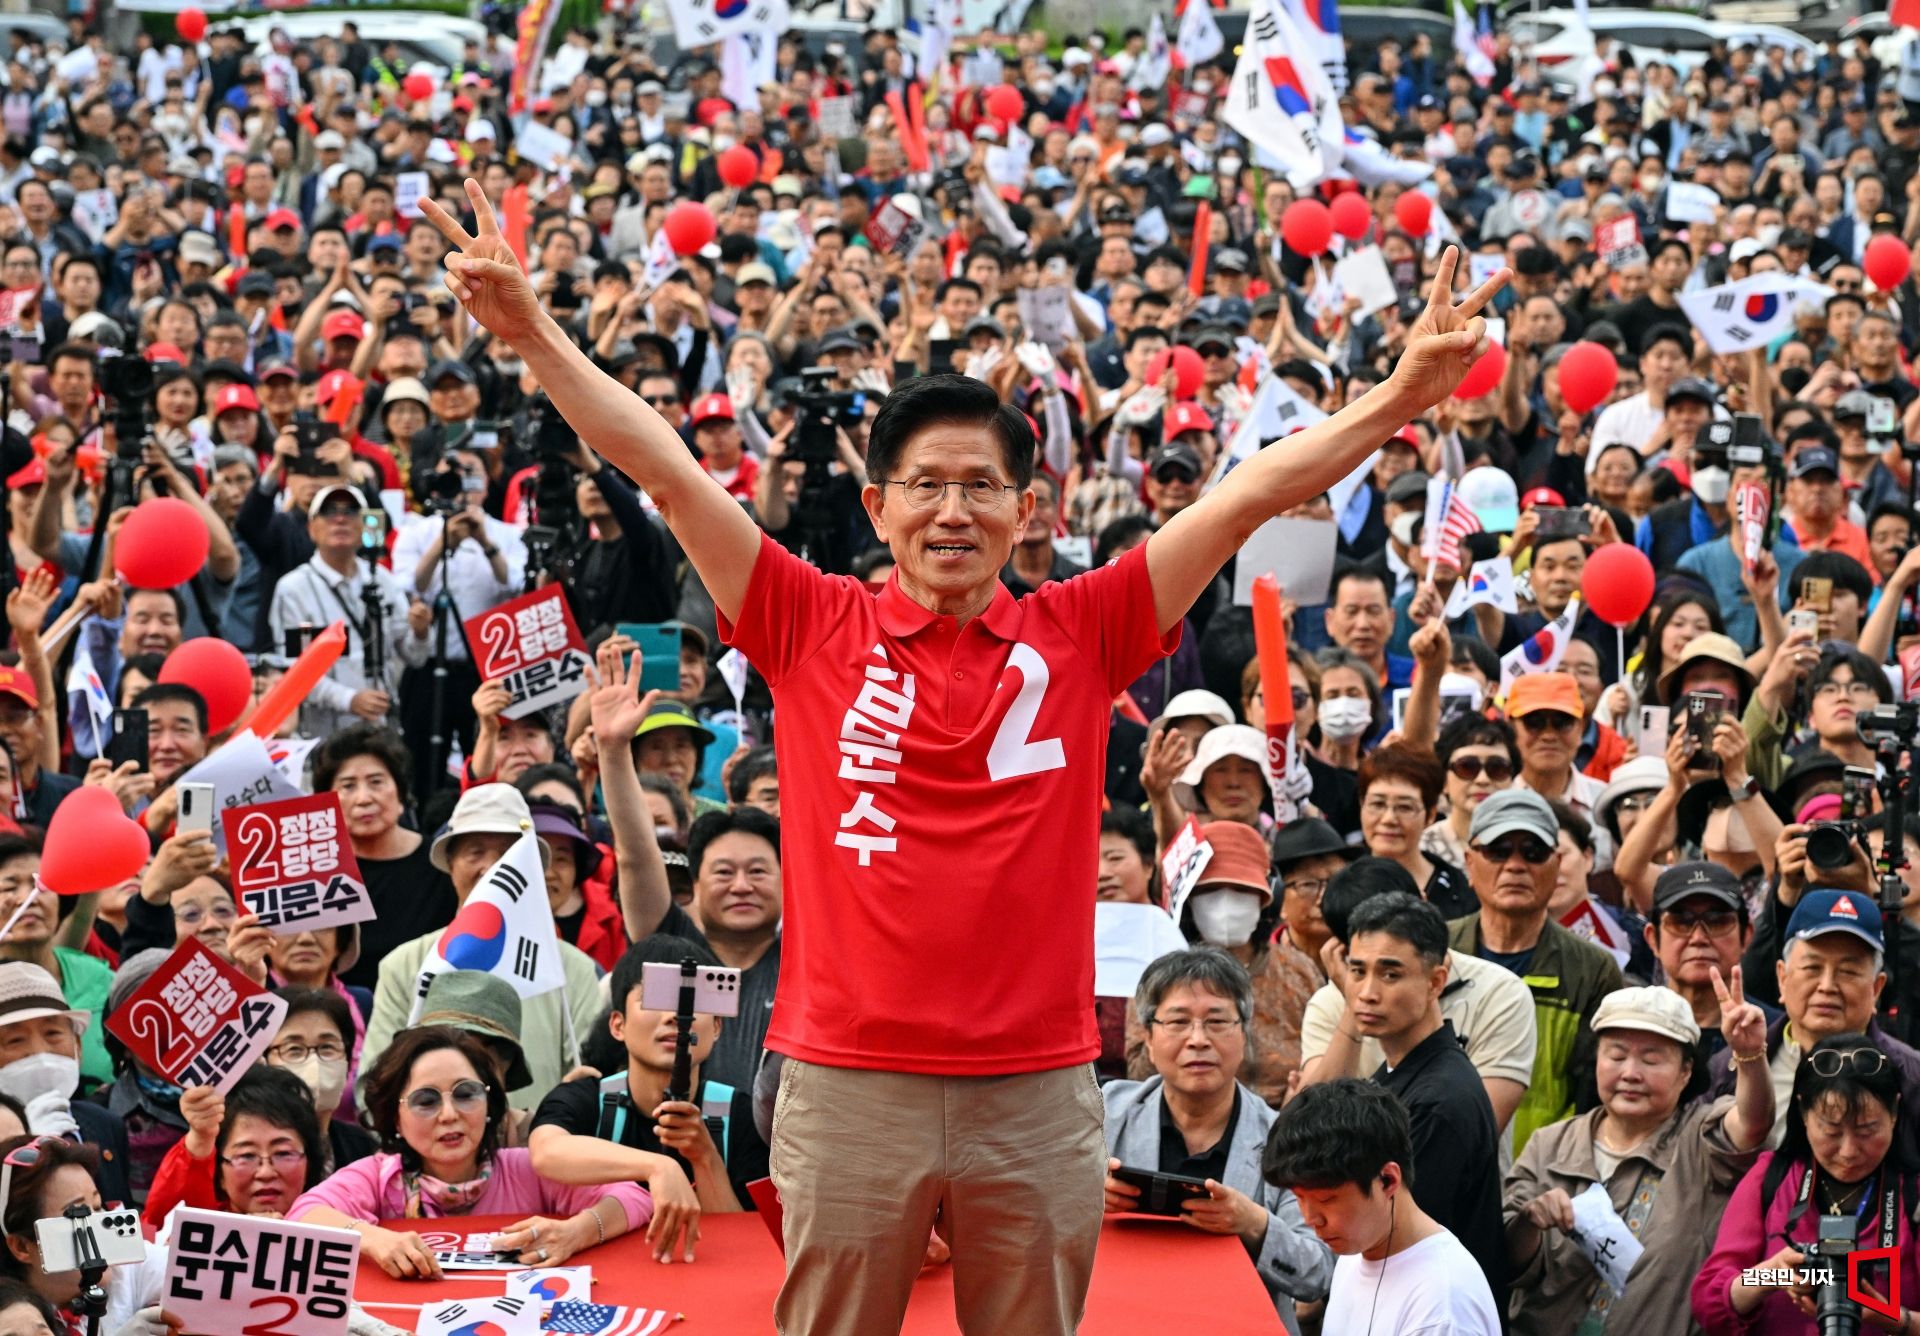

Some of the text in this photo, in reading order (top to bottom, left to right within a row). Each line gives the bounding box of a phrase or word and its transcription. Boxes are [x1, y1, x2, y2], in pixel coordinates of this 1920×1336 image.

[480, 612, 521, 678] 2
[986, 642, 1067, 782] 2
[834, 643, 916, 866] 김문수
[238, 812, 279, 886] 2
[280, 808, 338, 846] 정정
[281, 839, 339, 878] 당당
[245, 876, 361, 926] 김문수
[160, 951, 217, 1014] 정정
[181, 975, 238, 1038] 당당
[130, 1000, 195, 1074] 2
[176, 1000, 275, 1087] 김문수
[170, 1221, 353, 1319] 문수대통
[242, 1295, 300, 1336] 2
